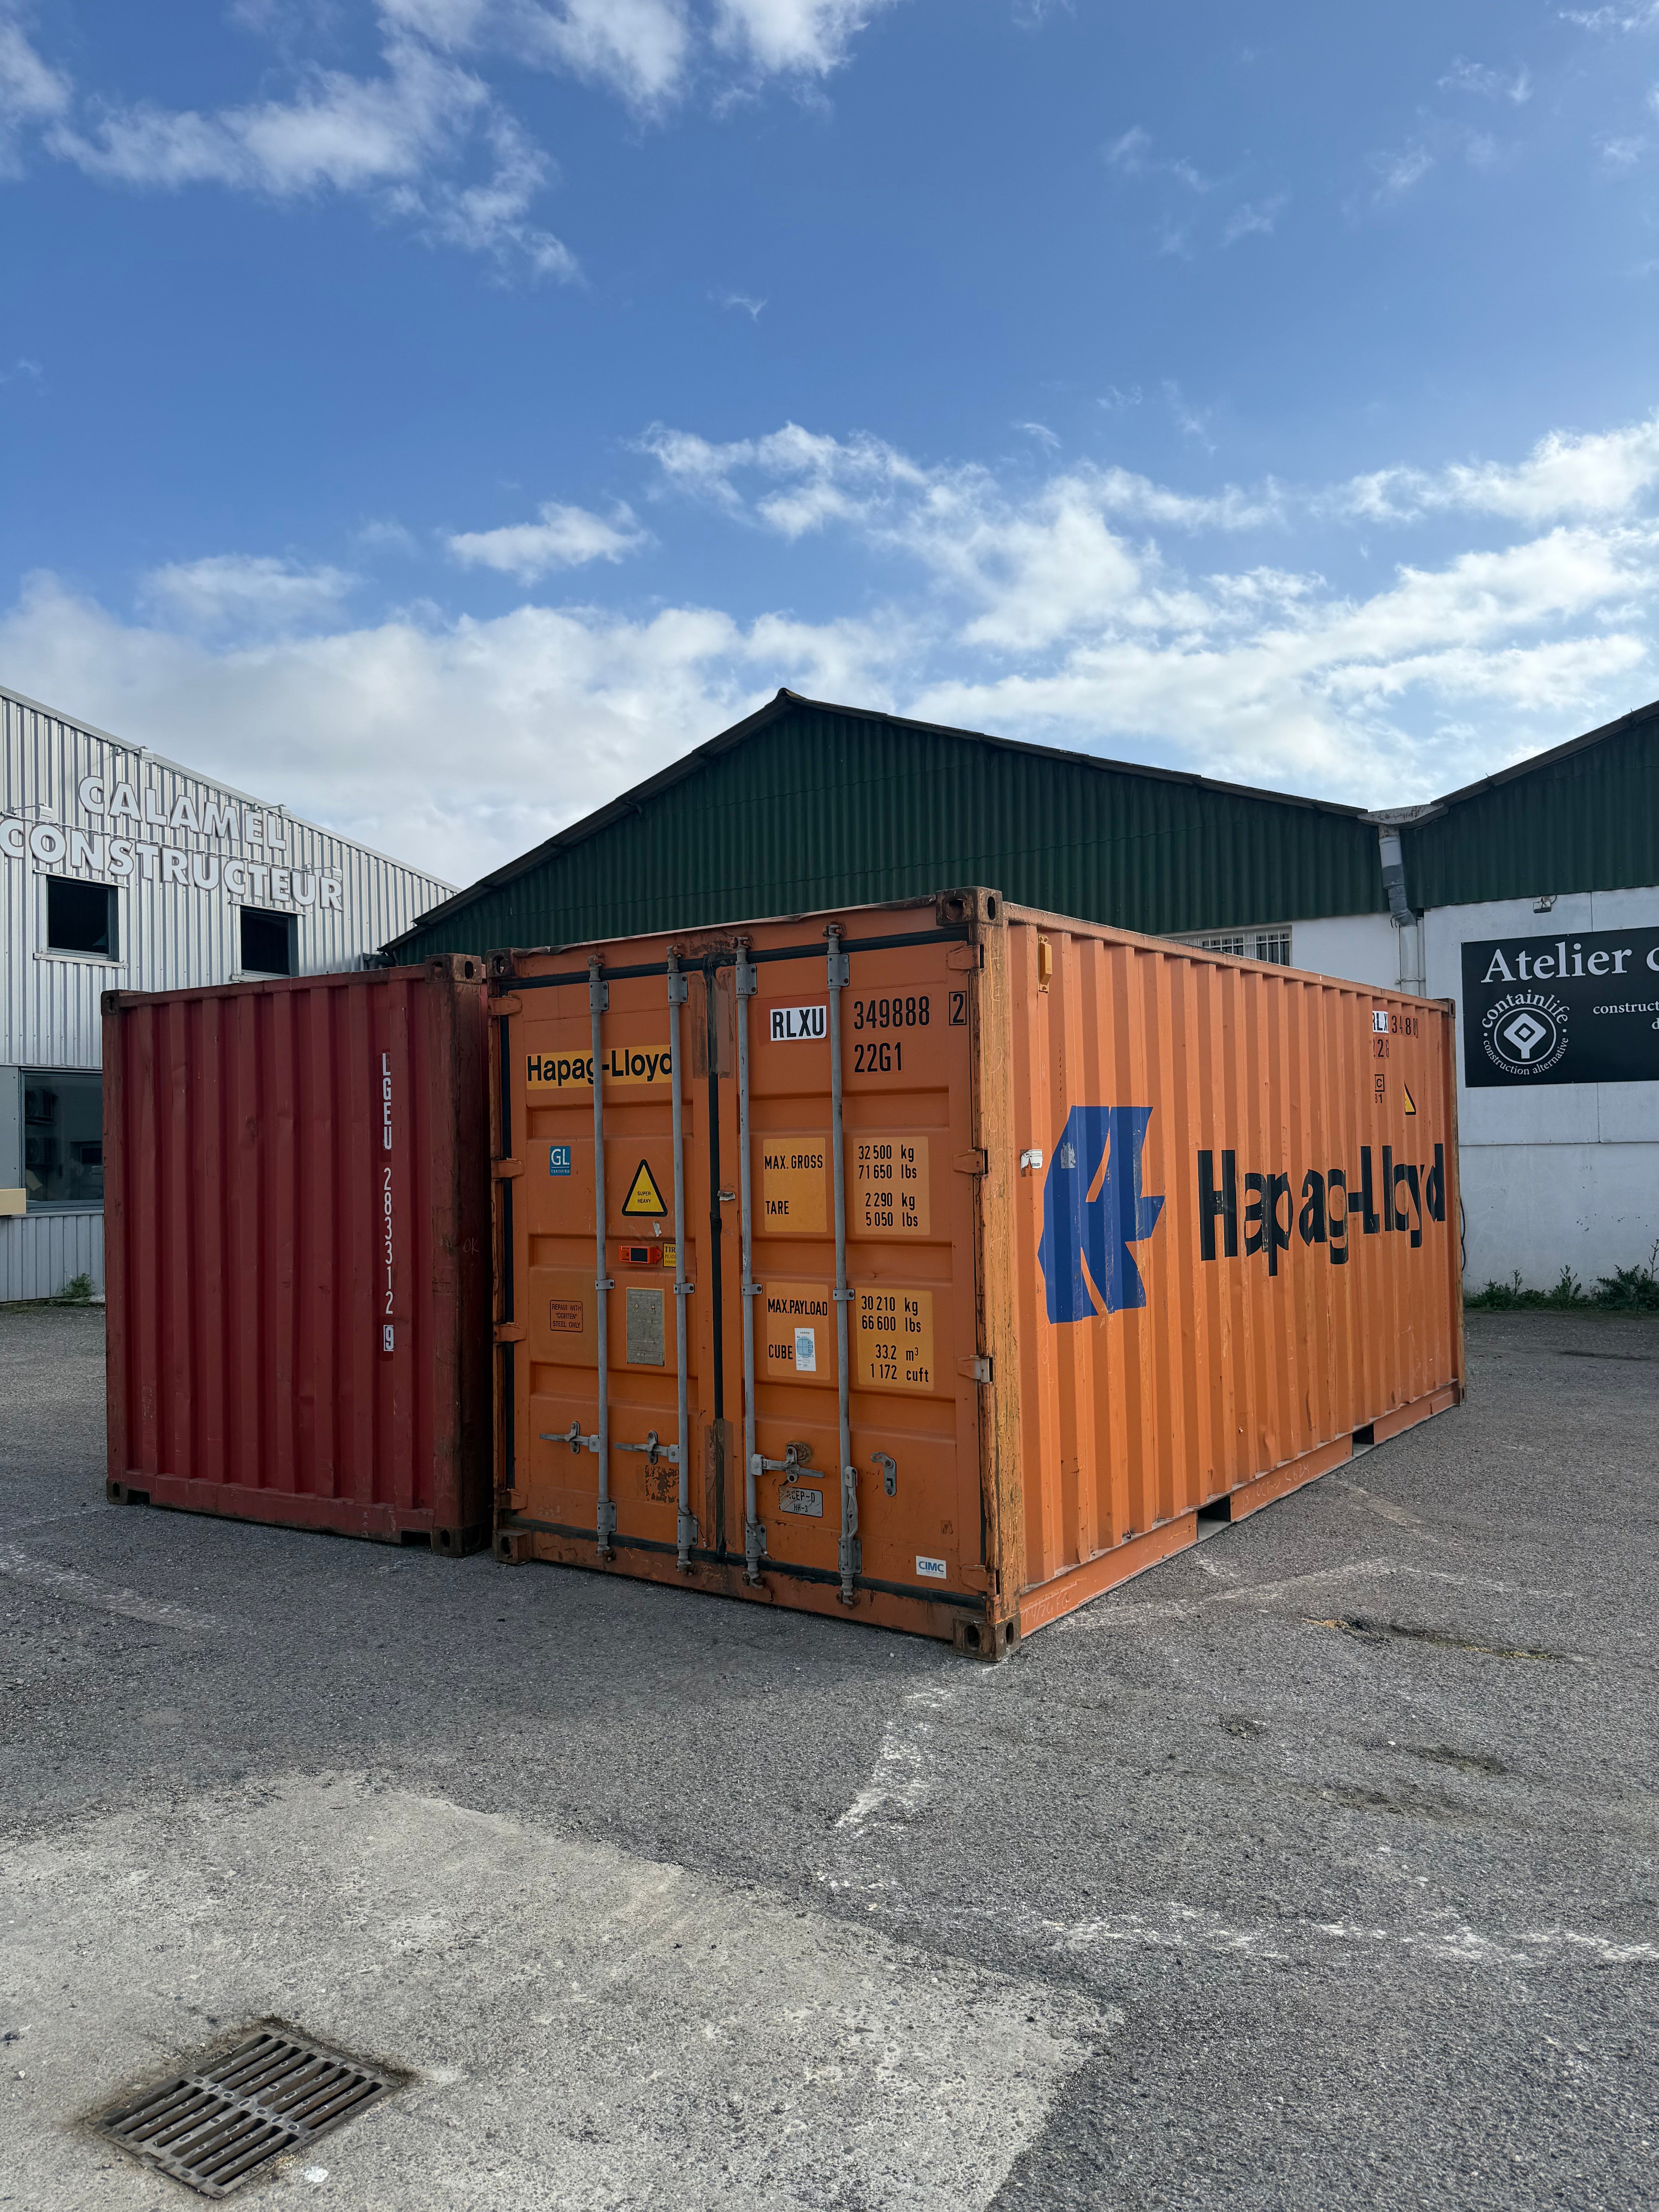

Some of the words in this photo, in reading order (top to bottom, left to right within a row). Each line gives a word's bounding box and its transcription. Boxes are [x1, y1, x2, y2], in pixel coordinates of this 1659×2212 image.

[78, 776, 287, 851] CALAMEL
[0, 818, 344, 911] CONSTRUCTEUR
[1481, 941, 1632, 983] Atelier
[773, 1008, 824, 1039] RLXU
[854, 996, 930, 1030] 349888
[953, 993, 964, 1023] 2
[1482, 989, 1570, 1029] containlife
[854, 1041, 902, 1073] 22G1
[1483, 1040, 1530, 1075] construction
[1532, 1037, 1569, 1074] alternative
[527, 1046, 672, 1086] Hapag-Lloyd
[382, 1053, 392, 1149] LGEU
[764, 1156, 789, 1170] MAX.
[791, 1154, 823, 1169] GROSS
[901, 1144, 914, 1162] kg
[901, 1164, 917, 1179] lbs
[766, 1200, 790, 1215] TARE
[902, 1192, 915, 1211] kg
[1197, 1144, 1445, 1276] Hapag-Lloyd
[902, 1212, 918, 1227] lbs
[383, 1168, 393, 1314] 283312
[463, 1237, 479, 1255] OK
[905, 1297, 918, 1316] kg
[905, 1317, 921, 1333] lbs
[386, 1326, 393, 1350] 9
[768, 1344, 793, 1360] CUBE
[875, 1344, 897, 1360] 33.2
[906, 1367, 929, 1383] cuft
[794, 1503, 808, 1513] HH-3
[919, 1561, 944, 1573] CIMC
